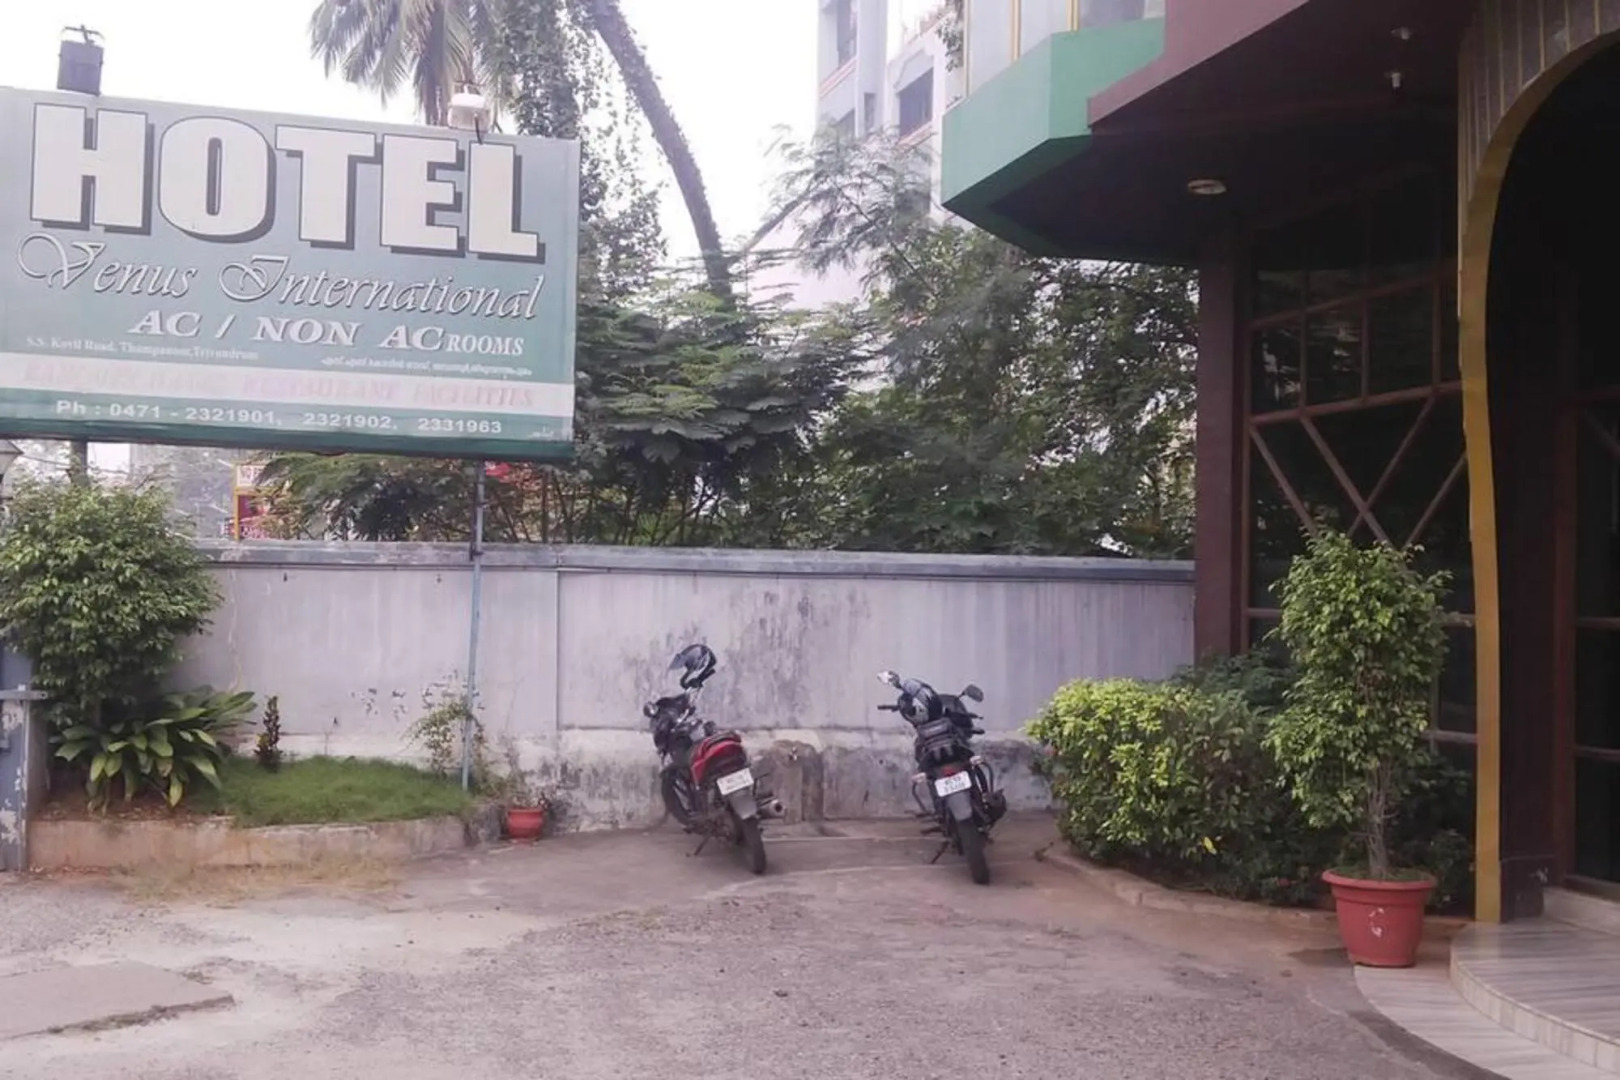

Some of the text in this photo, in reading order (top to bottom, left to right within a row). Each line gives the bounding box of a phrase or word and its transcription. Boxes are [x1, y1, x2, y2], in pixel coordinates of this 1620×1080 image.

[30, 103, 545, 262] HOTEL
[17, 234, 546, 319] Venus International
[126, 310, 202, 338] AC
[251, 316, 361, 346] NON
[380, 325, 446, 352] AC
[446, 334, 525, 356] ROOMS
[109, 402, 161, 418] 0471
[418, 417, 502, 434] 2331963
